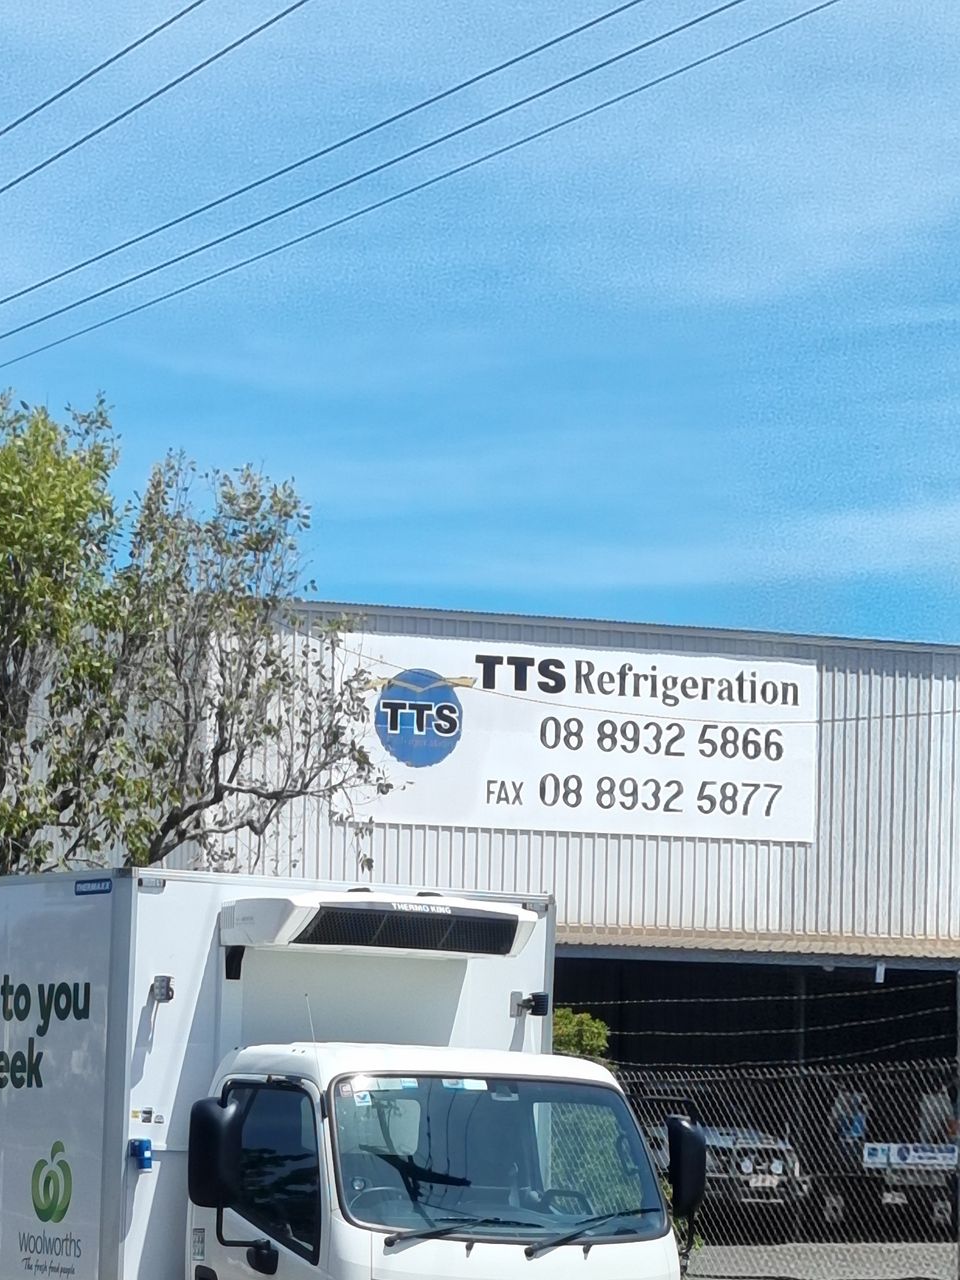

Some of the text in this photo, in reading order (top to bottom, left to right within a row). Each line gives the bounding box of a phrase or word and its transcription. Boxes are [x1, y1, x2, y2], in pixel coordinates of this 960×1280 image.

[475, 654, 800, 707] TTS Refrigeration
[381, 701, 459, 736] TTS
[540, 716, 784, 762] 08 8932 5866
[486, 773, 783, 817] FAX 08 8932 5877
[391, 902, 452, 914] THERMO KING
[1, 974, 31, 1021] to
[36, 982, 91, 1037] you
